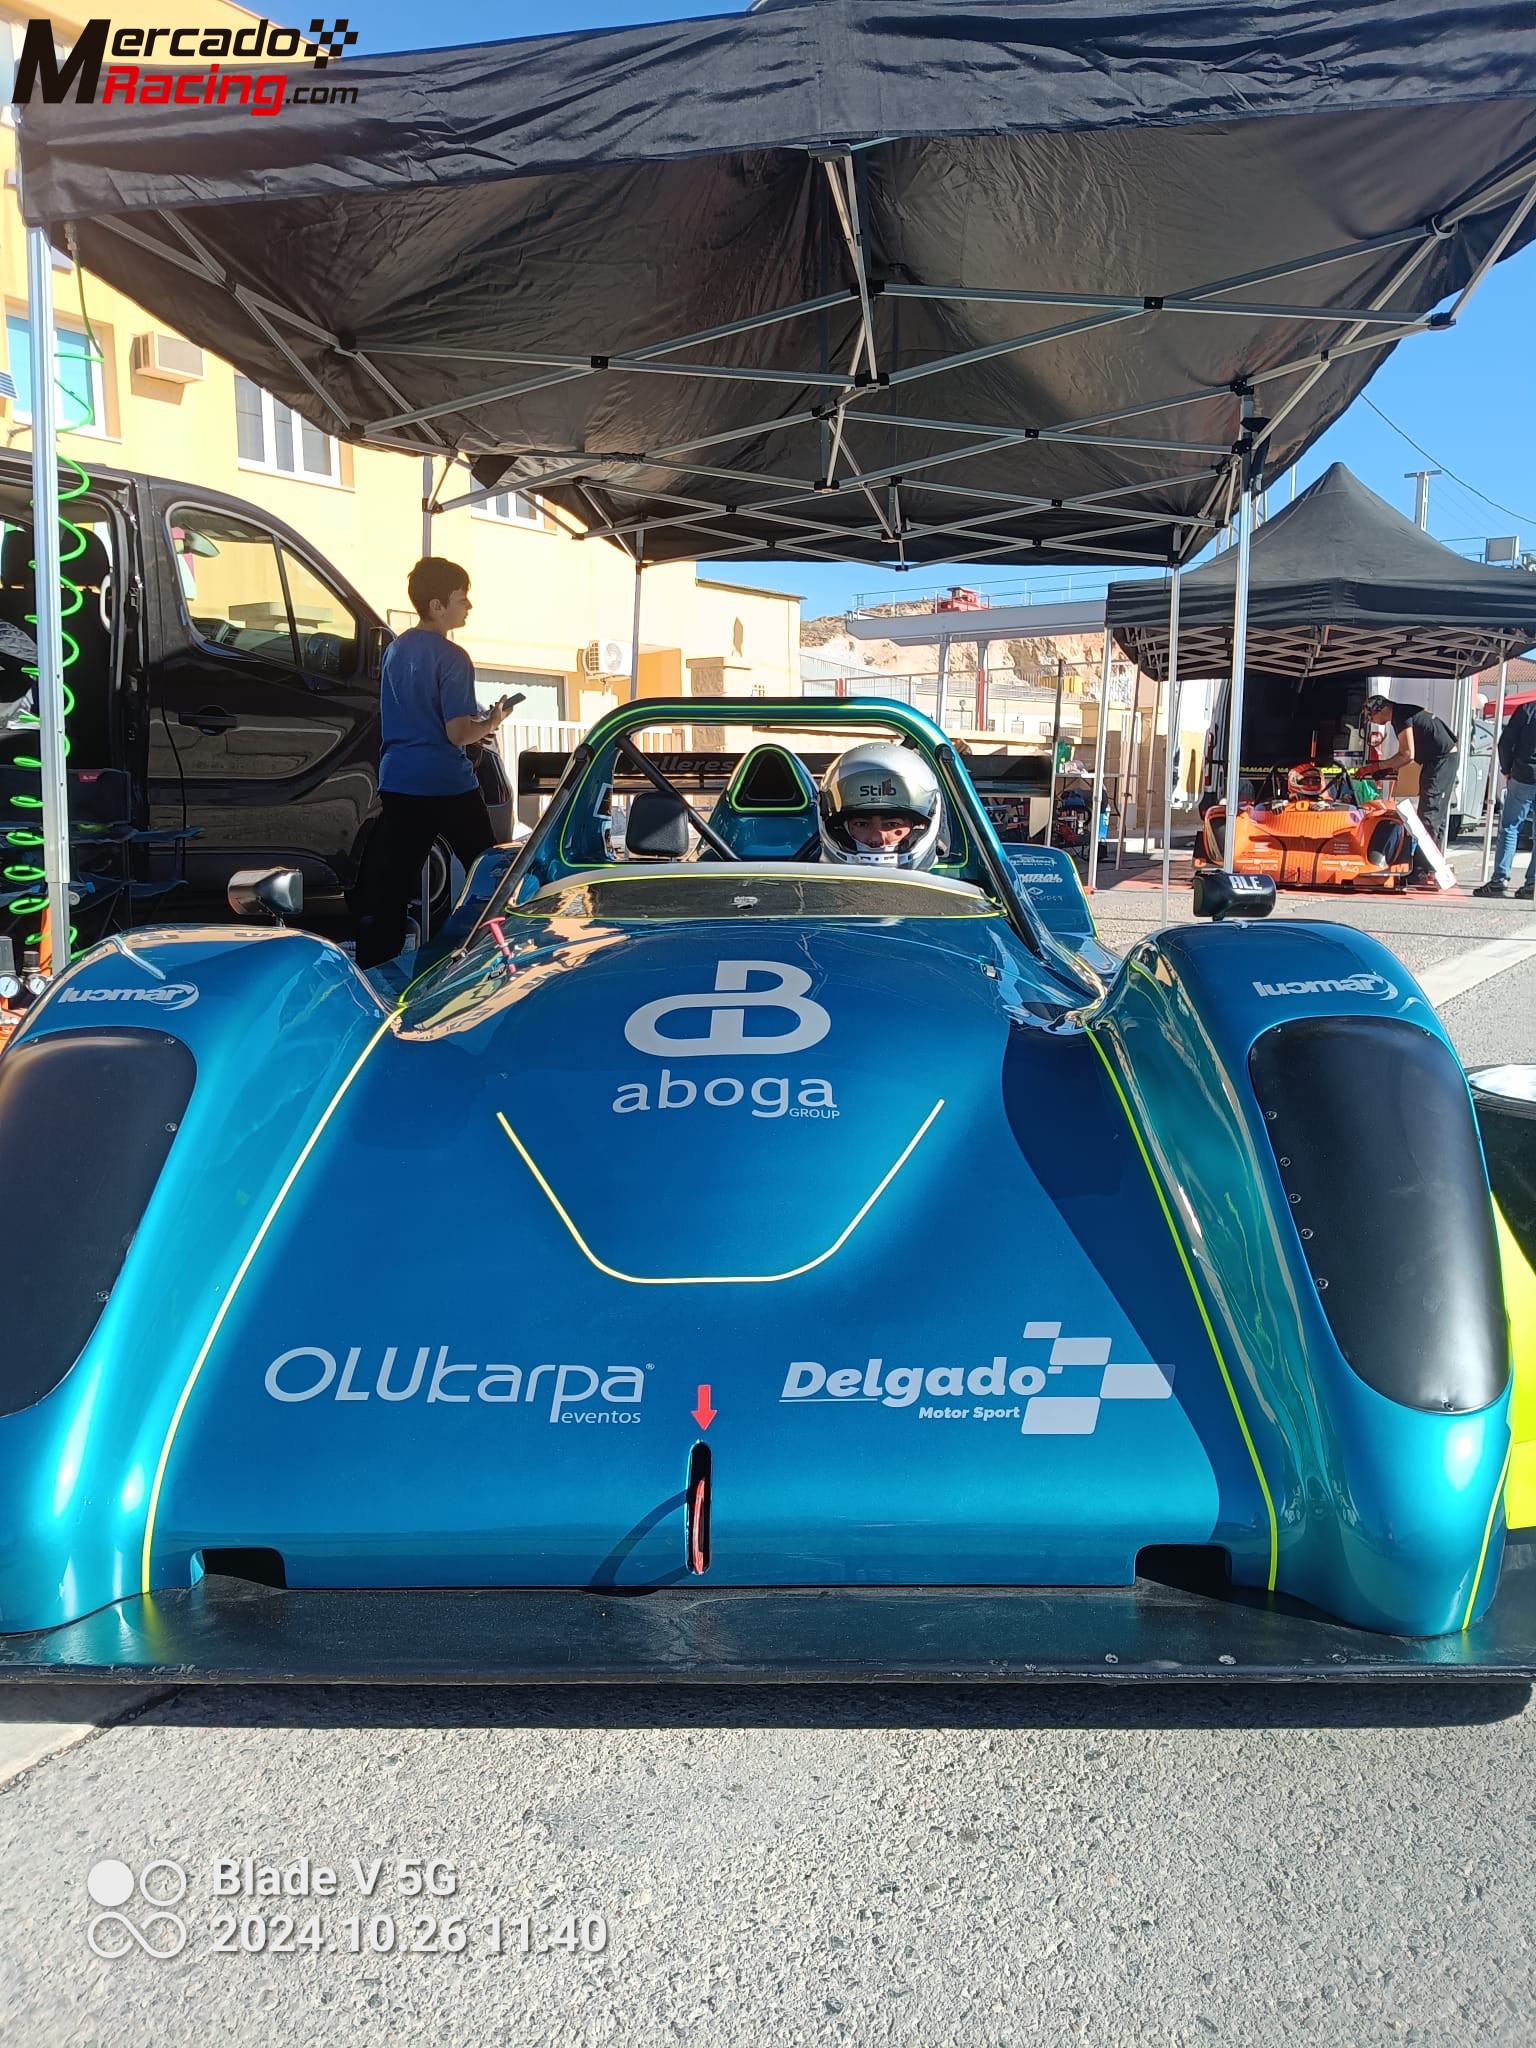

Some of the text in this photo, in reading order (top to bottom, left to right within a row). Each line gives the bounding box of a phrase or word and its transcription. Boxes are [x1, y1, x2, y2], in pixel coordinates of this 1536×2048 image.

[612, 1069, 837, 1118] aboga
[789, 1107, 840, 1119] GROUP
[781, 1356, 1046, 1408] Delgado
[561, 1410, 641, 1424] eventos
[919, 1405, 1021, 1421] Motor Sport
